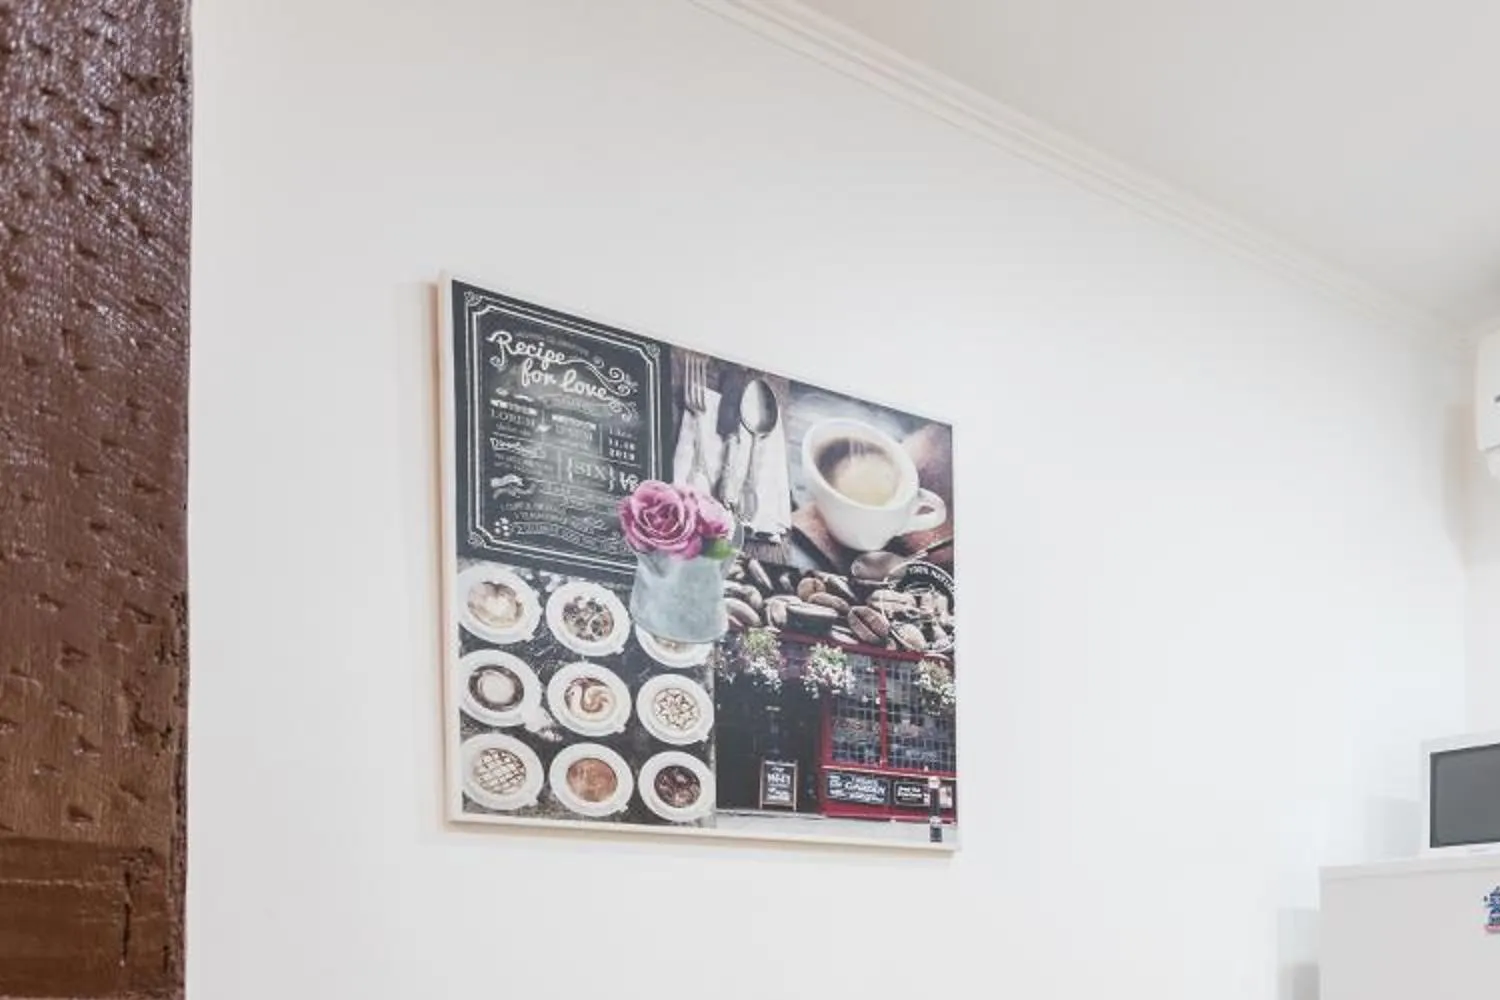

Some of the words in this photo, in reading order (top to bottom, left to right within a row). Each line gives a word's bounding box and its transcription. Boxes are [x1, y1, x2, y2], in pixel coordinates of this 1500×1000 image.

[488, 331, 566, 371] Recipe
[521, 358, 557, 388] for
[560, 368, 608, 400] love
